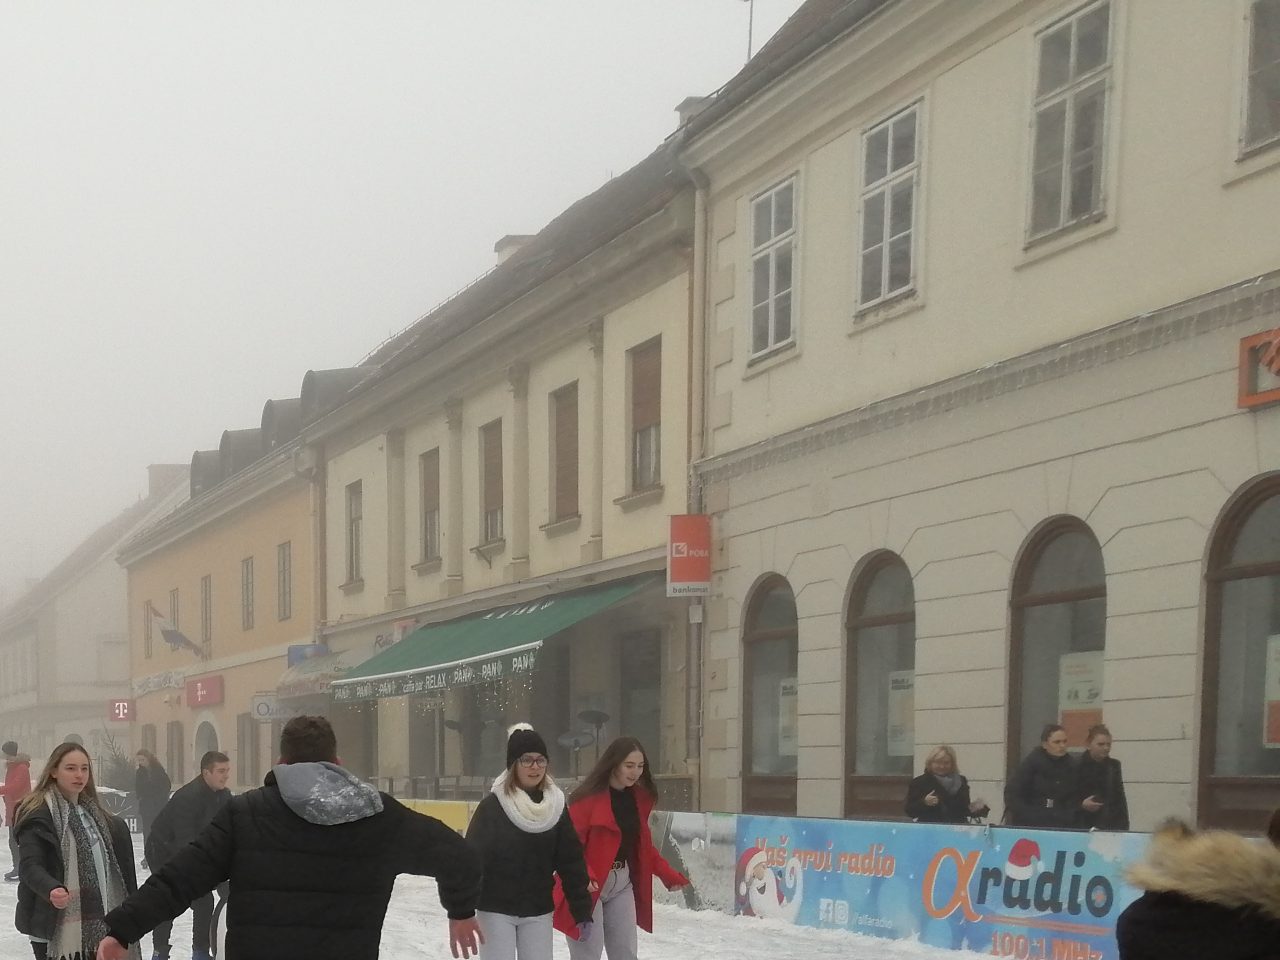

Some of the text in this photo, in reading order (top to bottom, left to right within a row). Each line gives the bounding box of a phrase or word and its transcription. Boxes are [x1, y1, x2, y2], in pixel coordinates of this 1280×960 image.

[482, 663, 497, 678] PAN
[512, 656, 529, 672] PAN
[837, 843, 896, 879] radio
